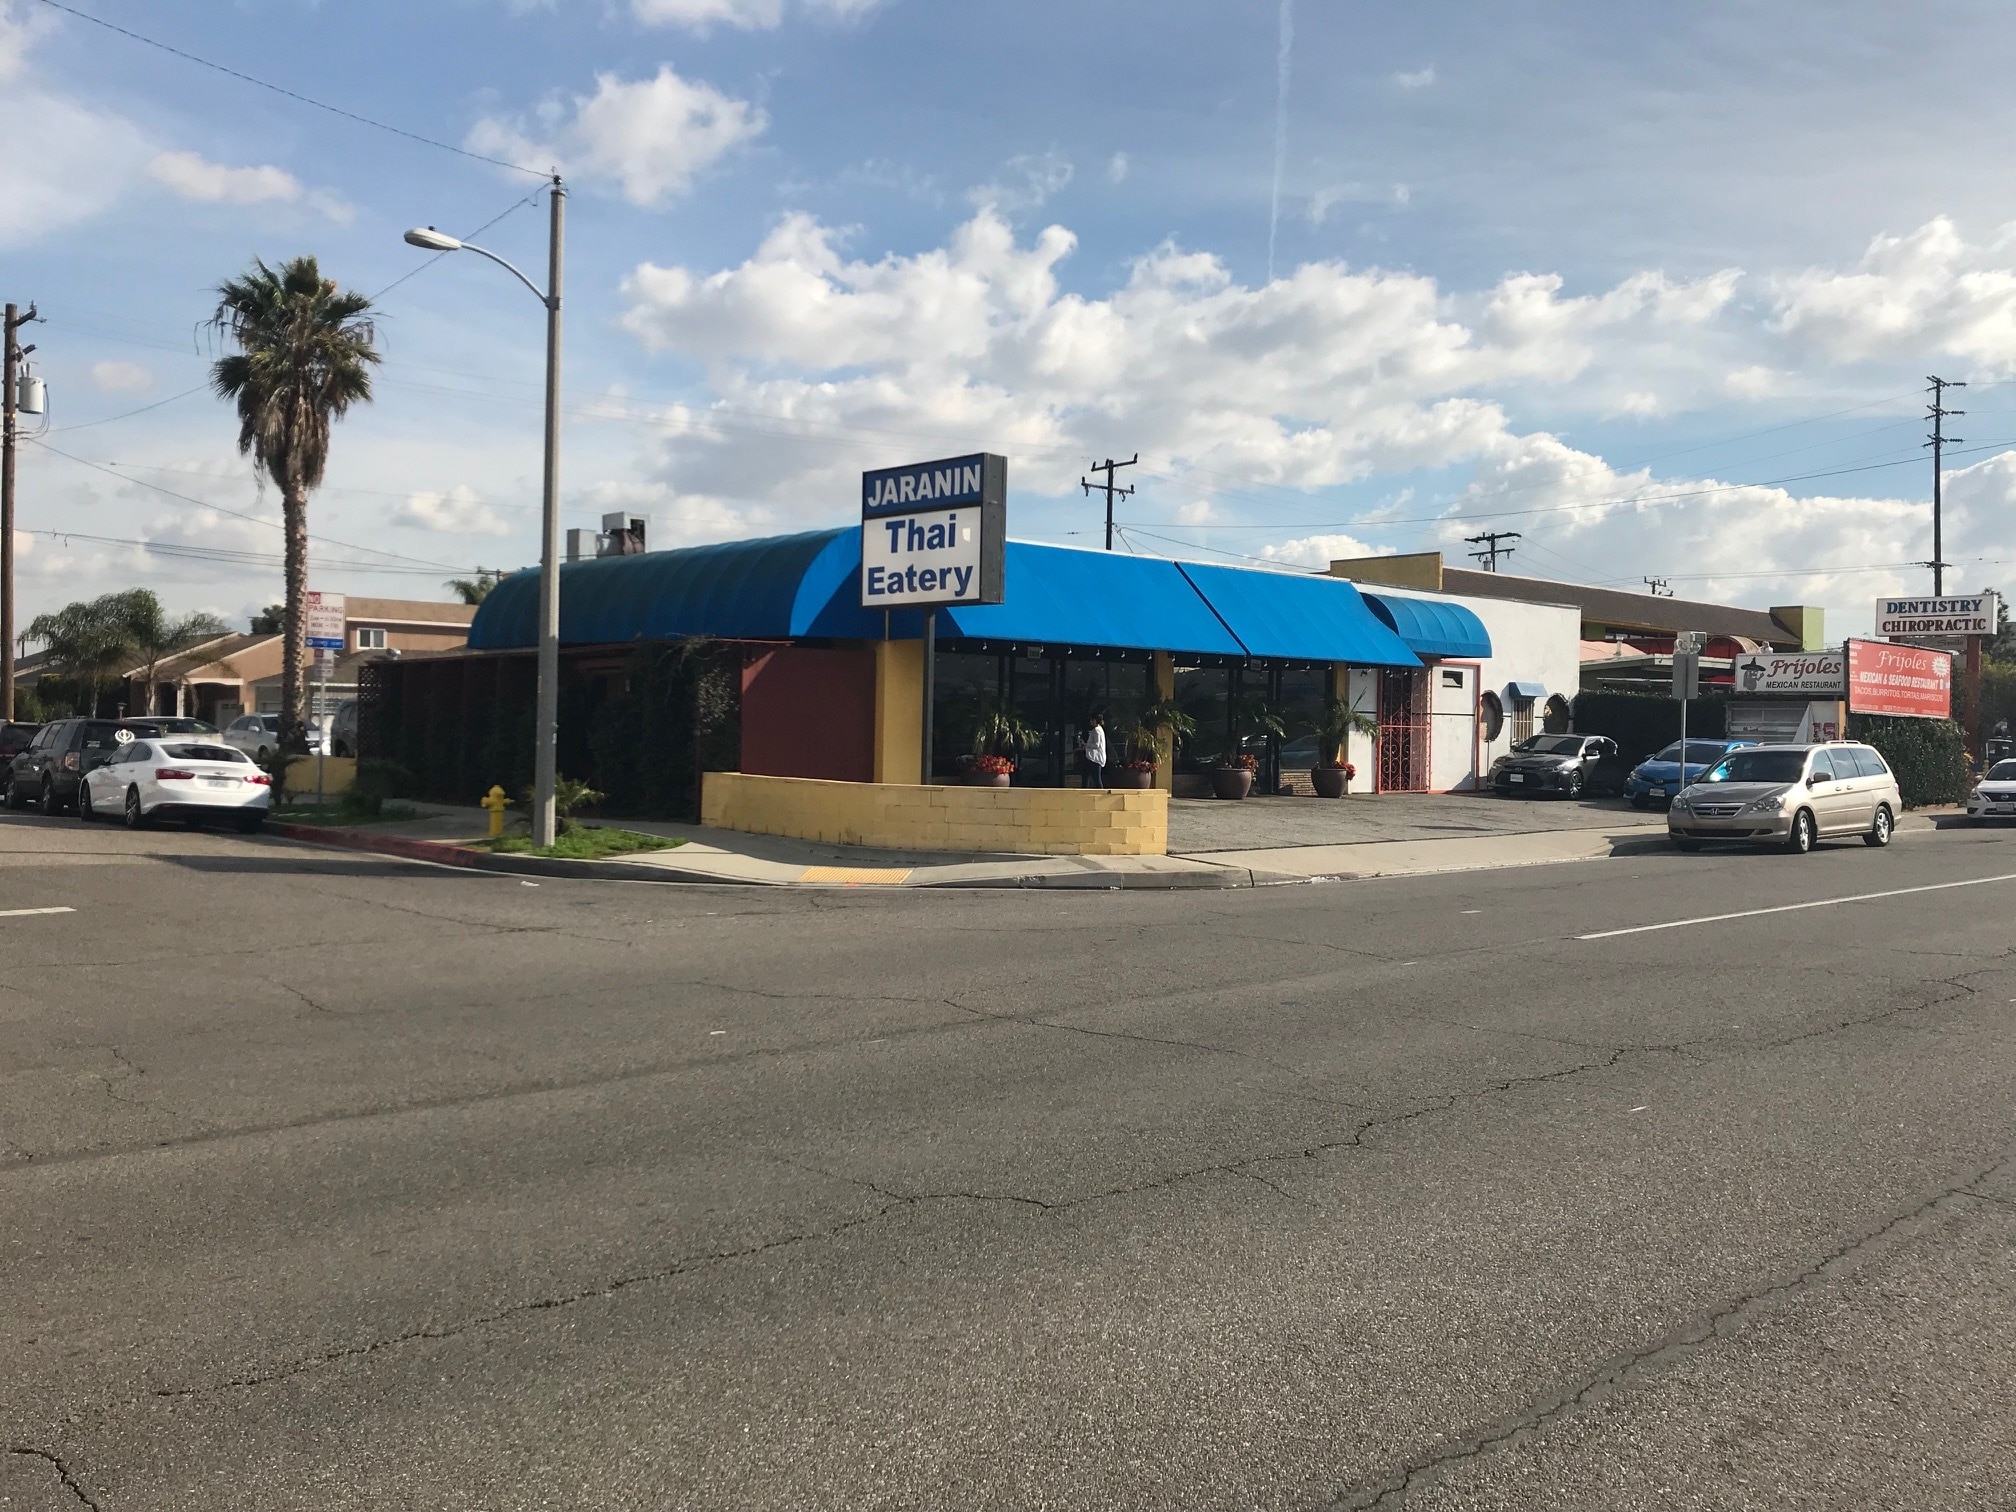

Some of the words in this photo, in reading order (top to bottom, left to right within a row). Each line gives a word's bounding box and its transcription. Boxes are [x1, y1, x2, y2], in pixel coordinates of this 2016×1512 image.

[868, 464, 981, 507] JARANIN
[885, 513, 957, 553] Thai
[868, 563, 974, 597] Eatery
[308, 594, 320, 604] NO
[1886, 599, 1983, 614] DENTISTRY
[308, 605, 344, 613] PARKING
[1882, 618, 1987, 632] CHIROPRACTIC
[1767, 657, 1842, 679] Frijoles
[1876, 650, 1927, 672] Frijoles
[1766, 681, 1798, 689] MEXICAN
[1800, 681, 1842, 689] RESTAURANT
[1860, 671, 1883, 685] MEXICAN
[1883, 674, 1888, 685] &
[1888, 674, 1911, 688] SEAFOOD
[1911, 677, 1938, 690] RESTAURANT
